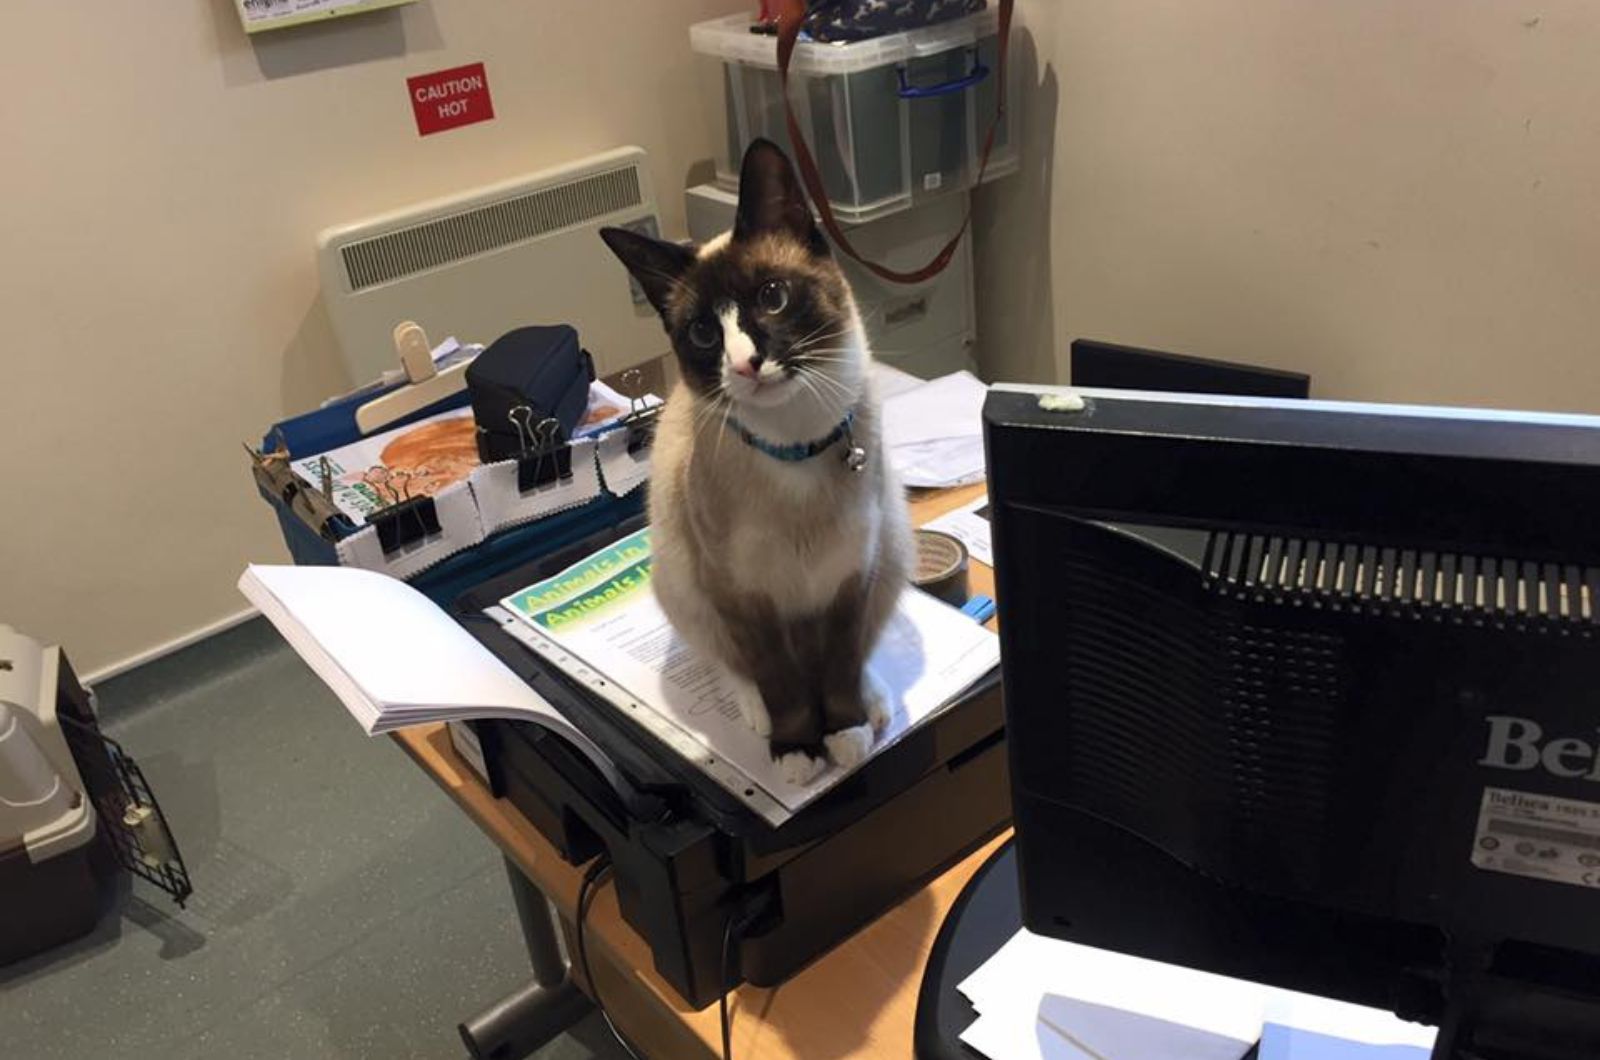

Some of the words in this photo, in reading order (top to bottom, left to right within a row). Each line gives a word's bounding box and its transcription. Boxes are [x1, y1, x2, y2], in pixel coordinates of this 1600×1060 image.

[415, 76, 483, 102] CAUTION
[438, 99, 468, 118] HOT
[527, 558, 614, 610] Animals
[546, 575, 637, 626] Animals
